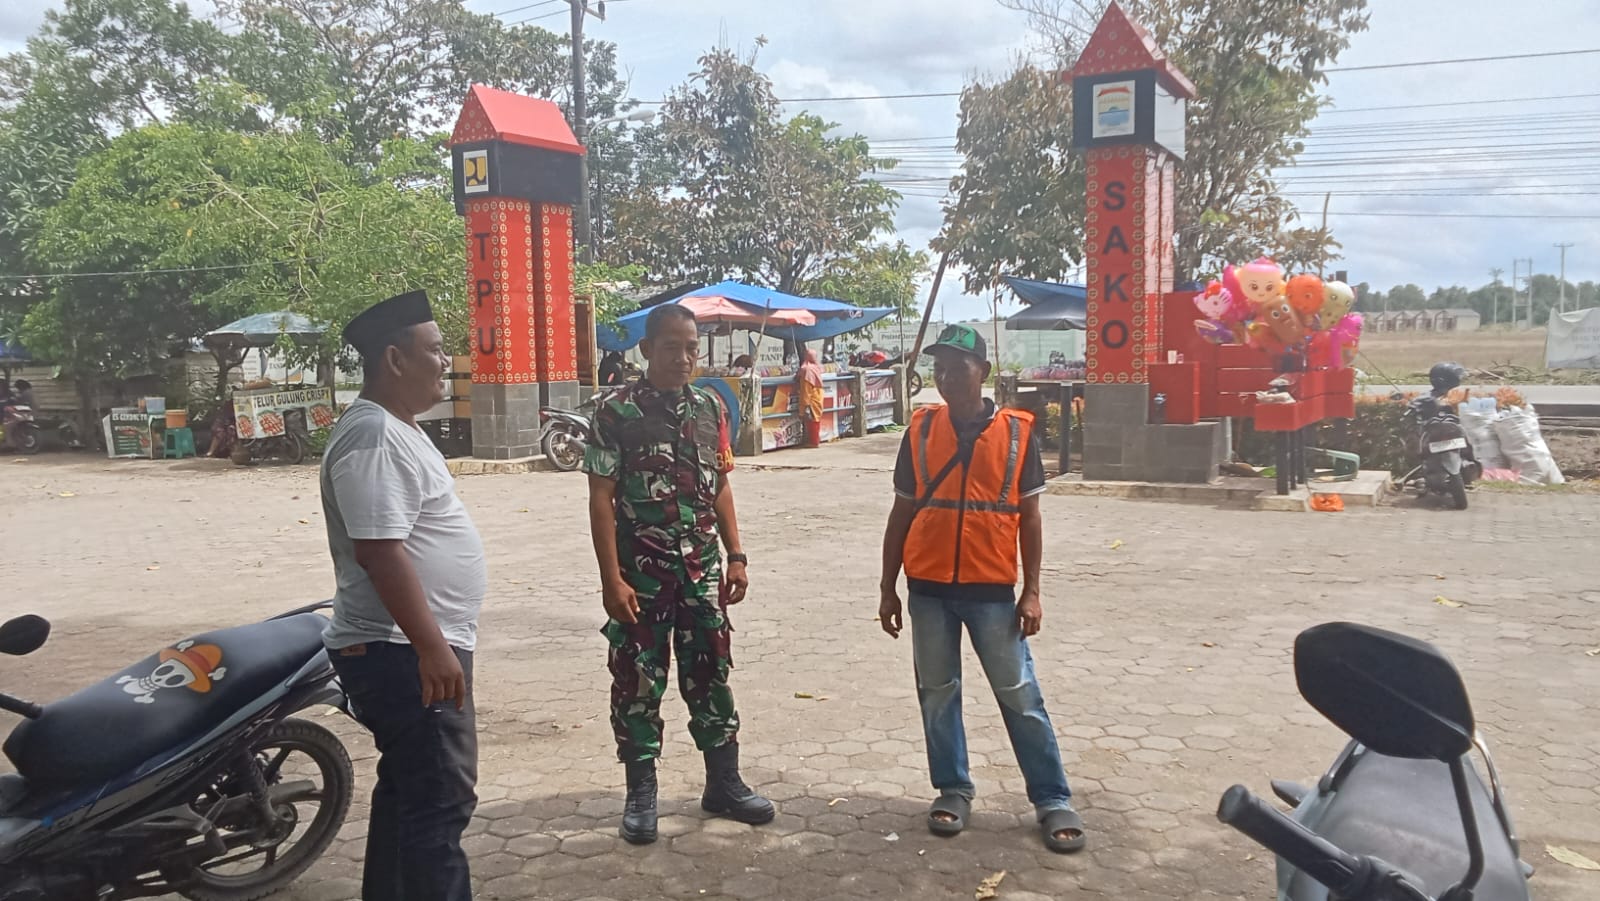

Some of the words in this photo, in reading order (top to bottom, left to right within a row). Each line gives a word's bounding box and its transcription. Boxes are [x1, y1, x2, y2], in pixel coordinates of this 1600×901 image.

[474, 232, 495, 355] TPU
[1102, 181, 1129, 349] SAKO
[253, 395, 276, 409] TELUR
[276, 391, 305, 405] GULUNG
[306, 387, 330, 401] CRISPY
